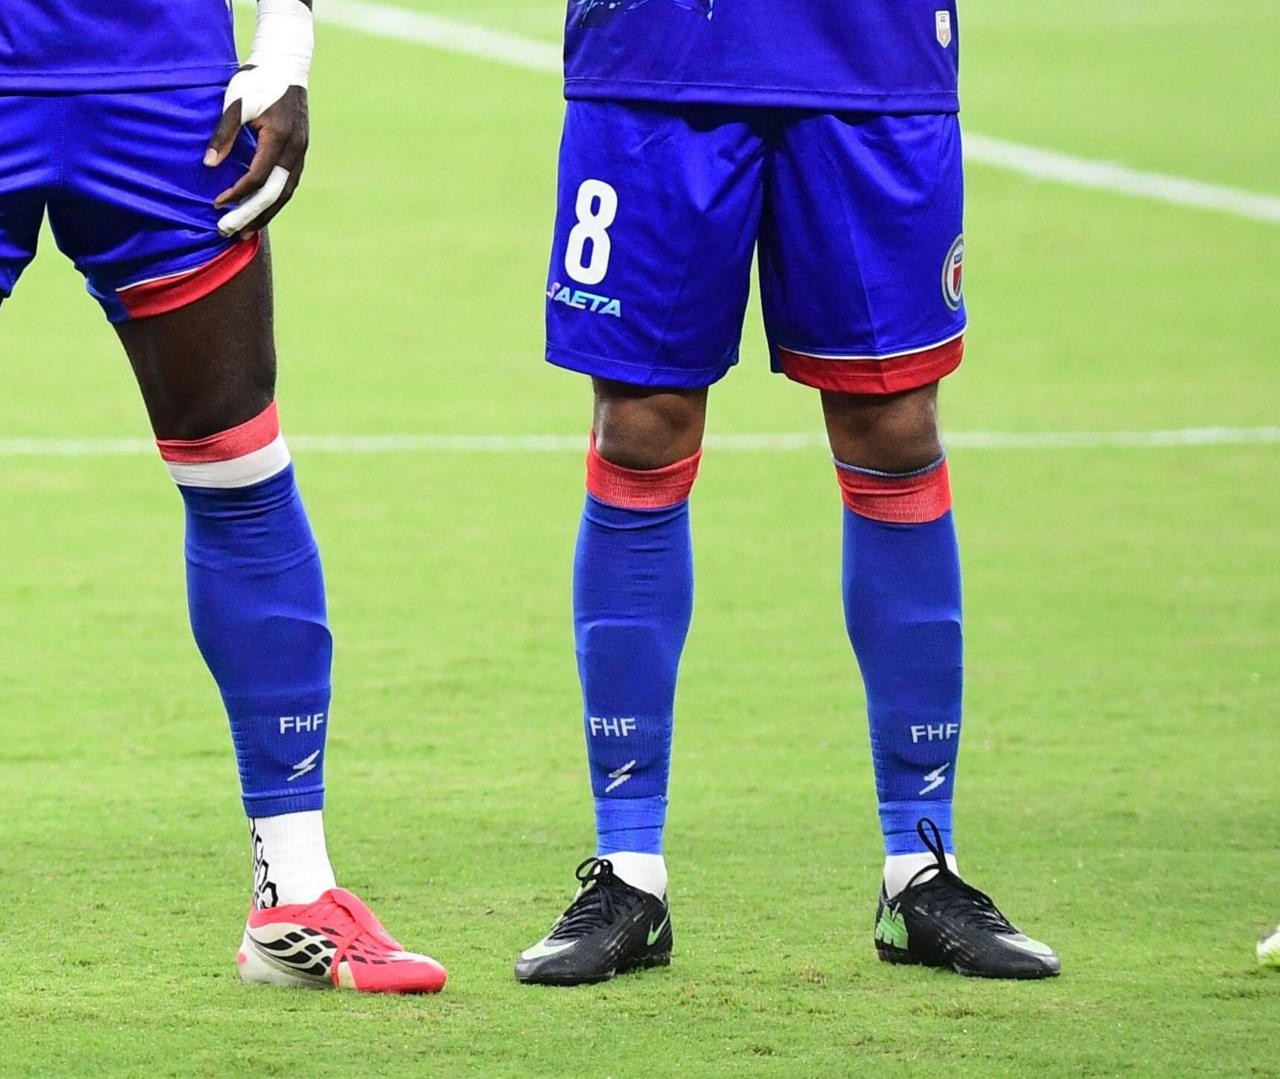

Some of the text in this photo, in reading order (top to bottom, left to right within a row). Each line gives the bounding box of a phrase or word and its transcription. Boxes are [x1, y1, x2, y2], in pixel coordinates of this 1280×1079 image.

[564, 178, 618, 285] 8
[546, 282, 622, 317] SAETA
[279, 712, 324, 735] FHF
[589, 716, 637, 737] FHF
[910, 723, 959, 744] FHF
